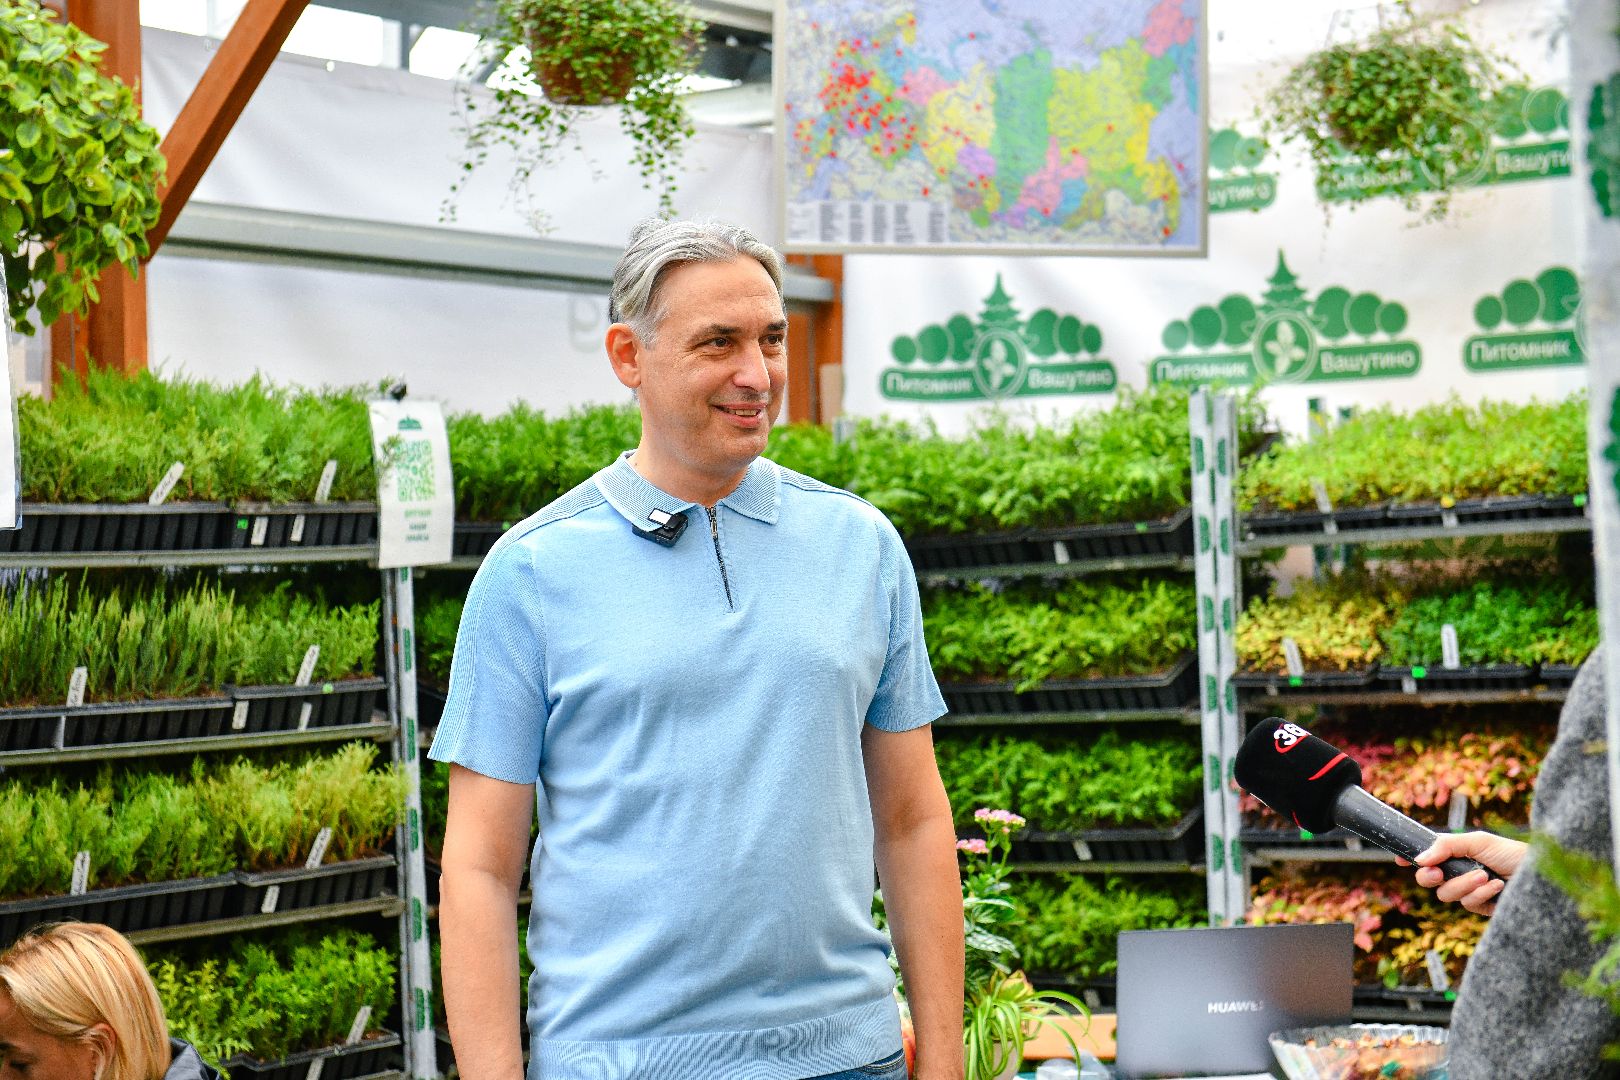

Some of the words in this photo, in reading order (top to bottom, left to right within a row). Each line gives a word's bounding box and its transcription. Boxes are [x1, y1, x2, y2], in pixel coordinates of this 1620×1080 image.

[1471, 339, 1570, 363] Питомник
[1156, 361, 1248, 382] Питомник
[1321, 350, 1415, 375] Вашутино
[886, 372, 972, 394] Питомник
[1028, 368, 1113, 392] Вашутино
